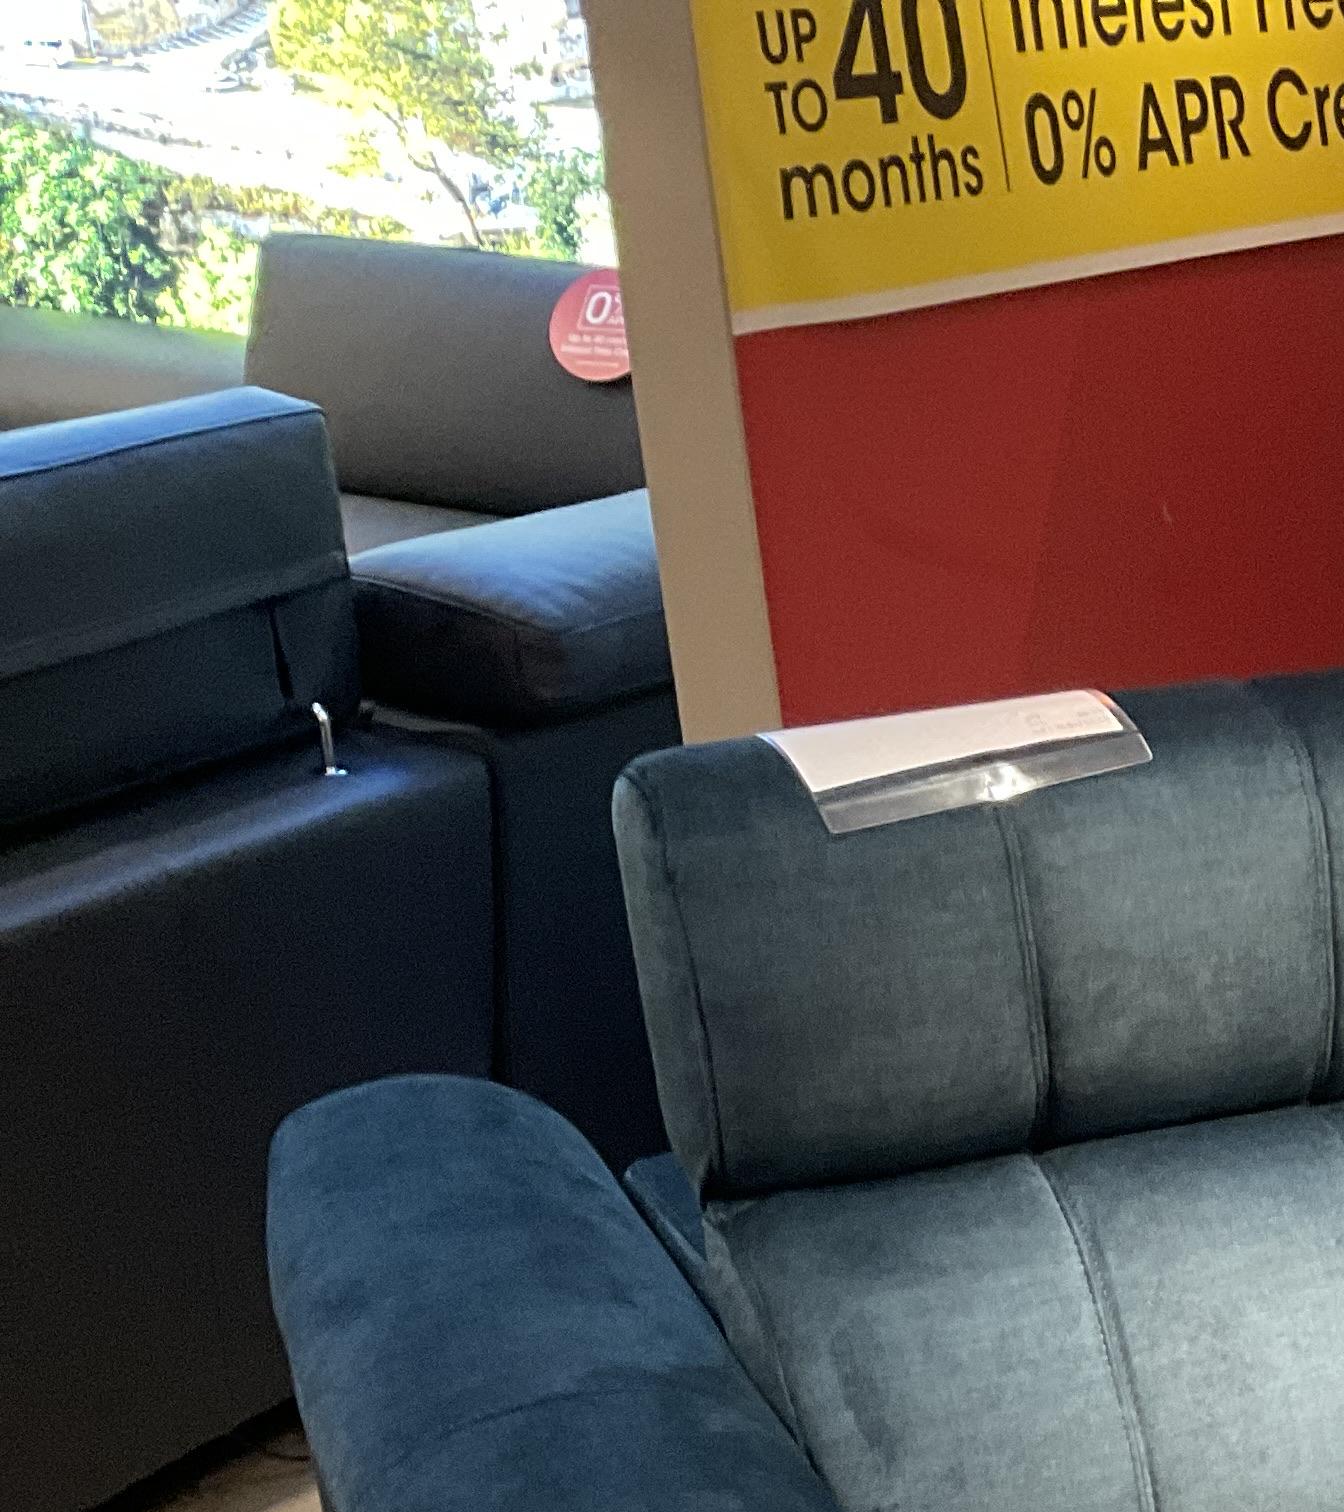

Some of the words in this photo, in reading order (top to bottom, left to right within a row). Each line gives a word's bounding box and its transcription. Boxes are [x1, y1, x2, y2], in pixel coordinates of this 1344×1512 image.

[755, 8, 817, 64] UP
[832, 0, 968, 124] 40
[763, 78, 829, 135] TO
[1024, 88, 1117, 186] 0%
[1138, 74, 1252, 172] APR
[779, 133, 985, 220] months
